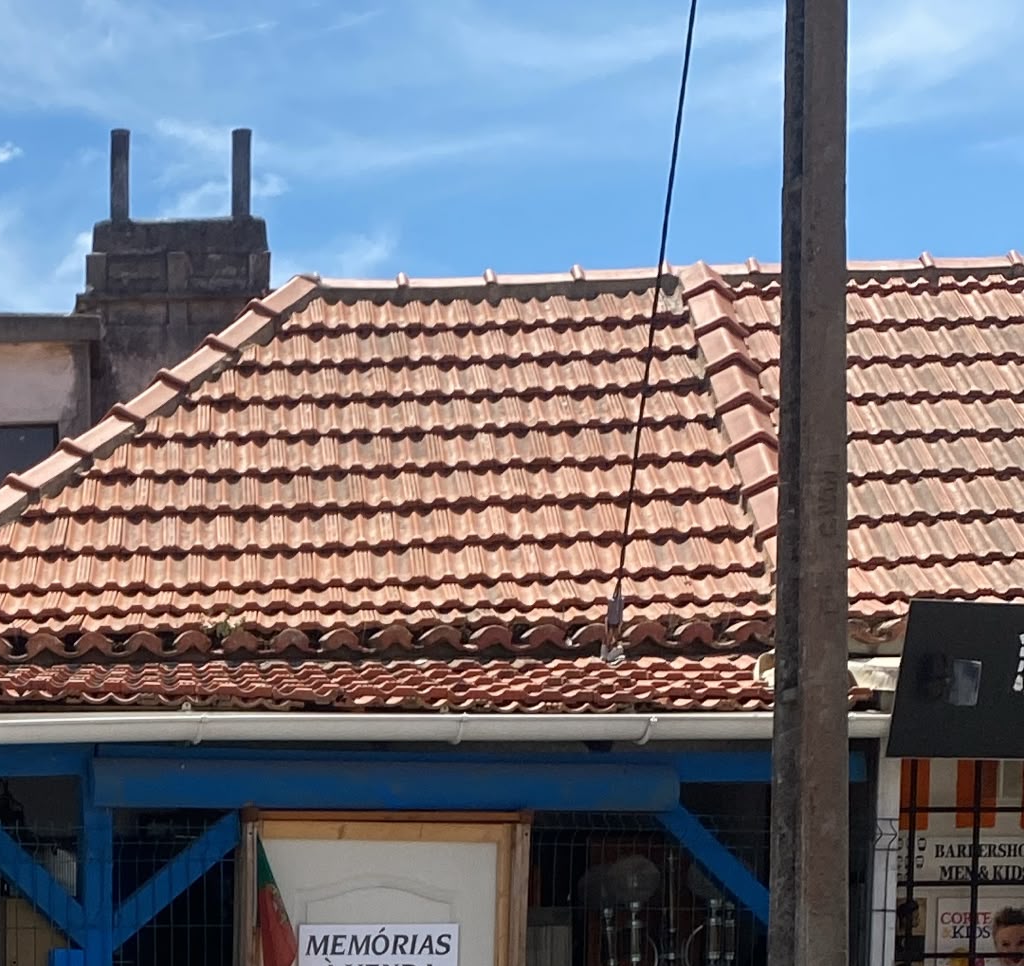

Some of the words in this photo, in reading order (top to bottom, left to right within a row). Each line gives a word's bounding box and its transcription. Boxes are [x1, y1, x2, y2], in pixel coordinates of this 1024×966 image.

[992, 865, 1024, 881] KID
[940, 912, 992, 925] CORTE
[305, 927, 452, 956] MEMÓRIAS
